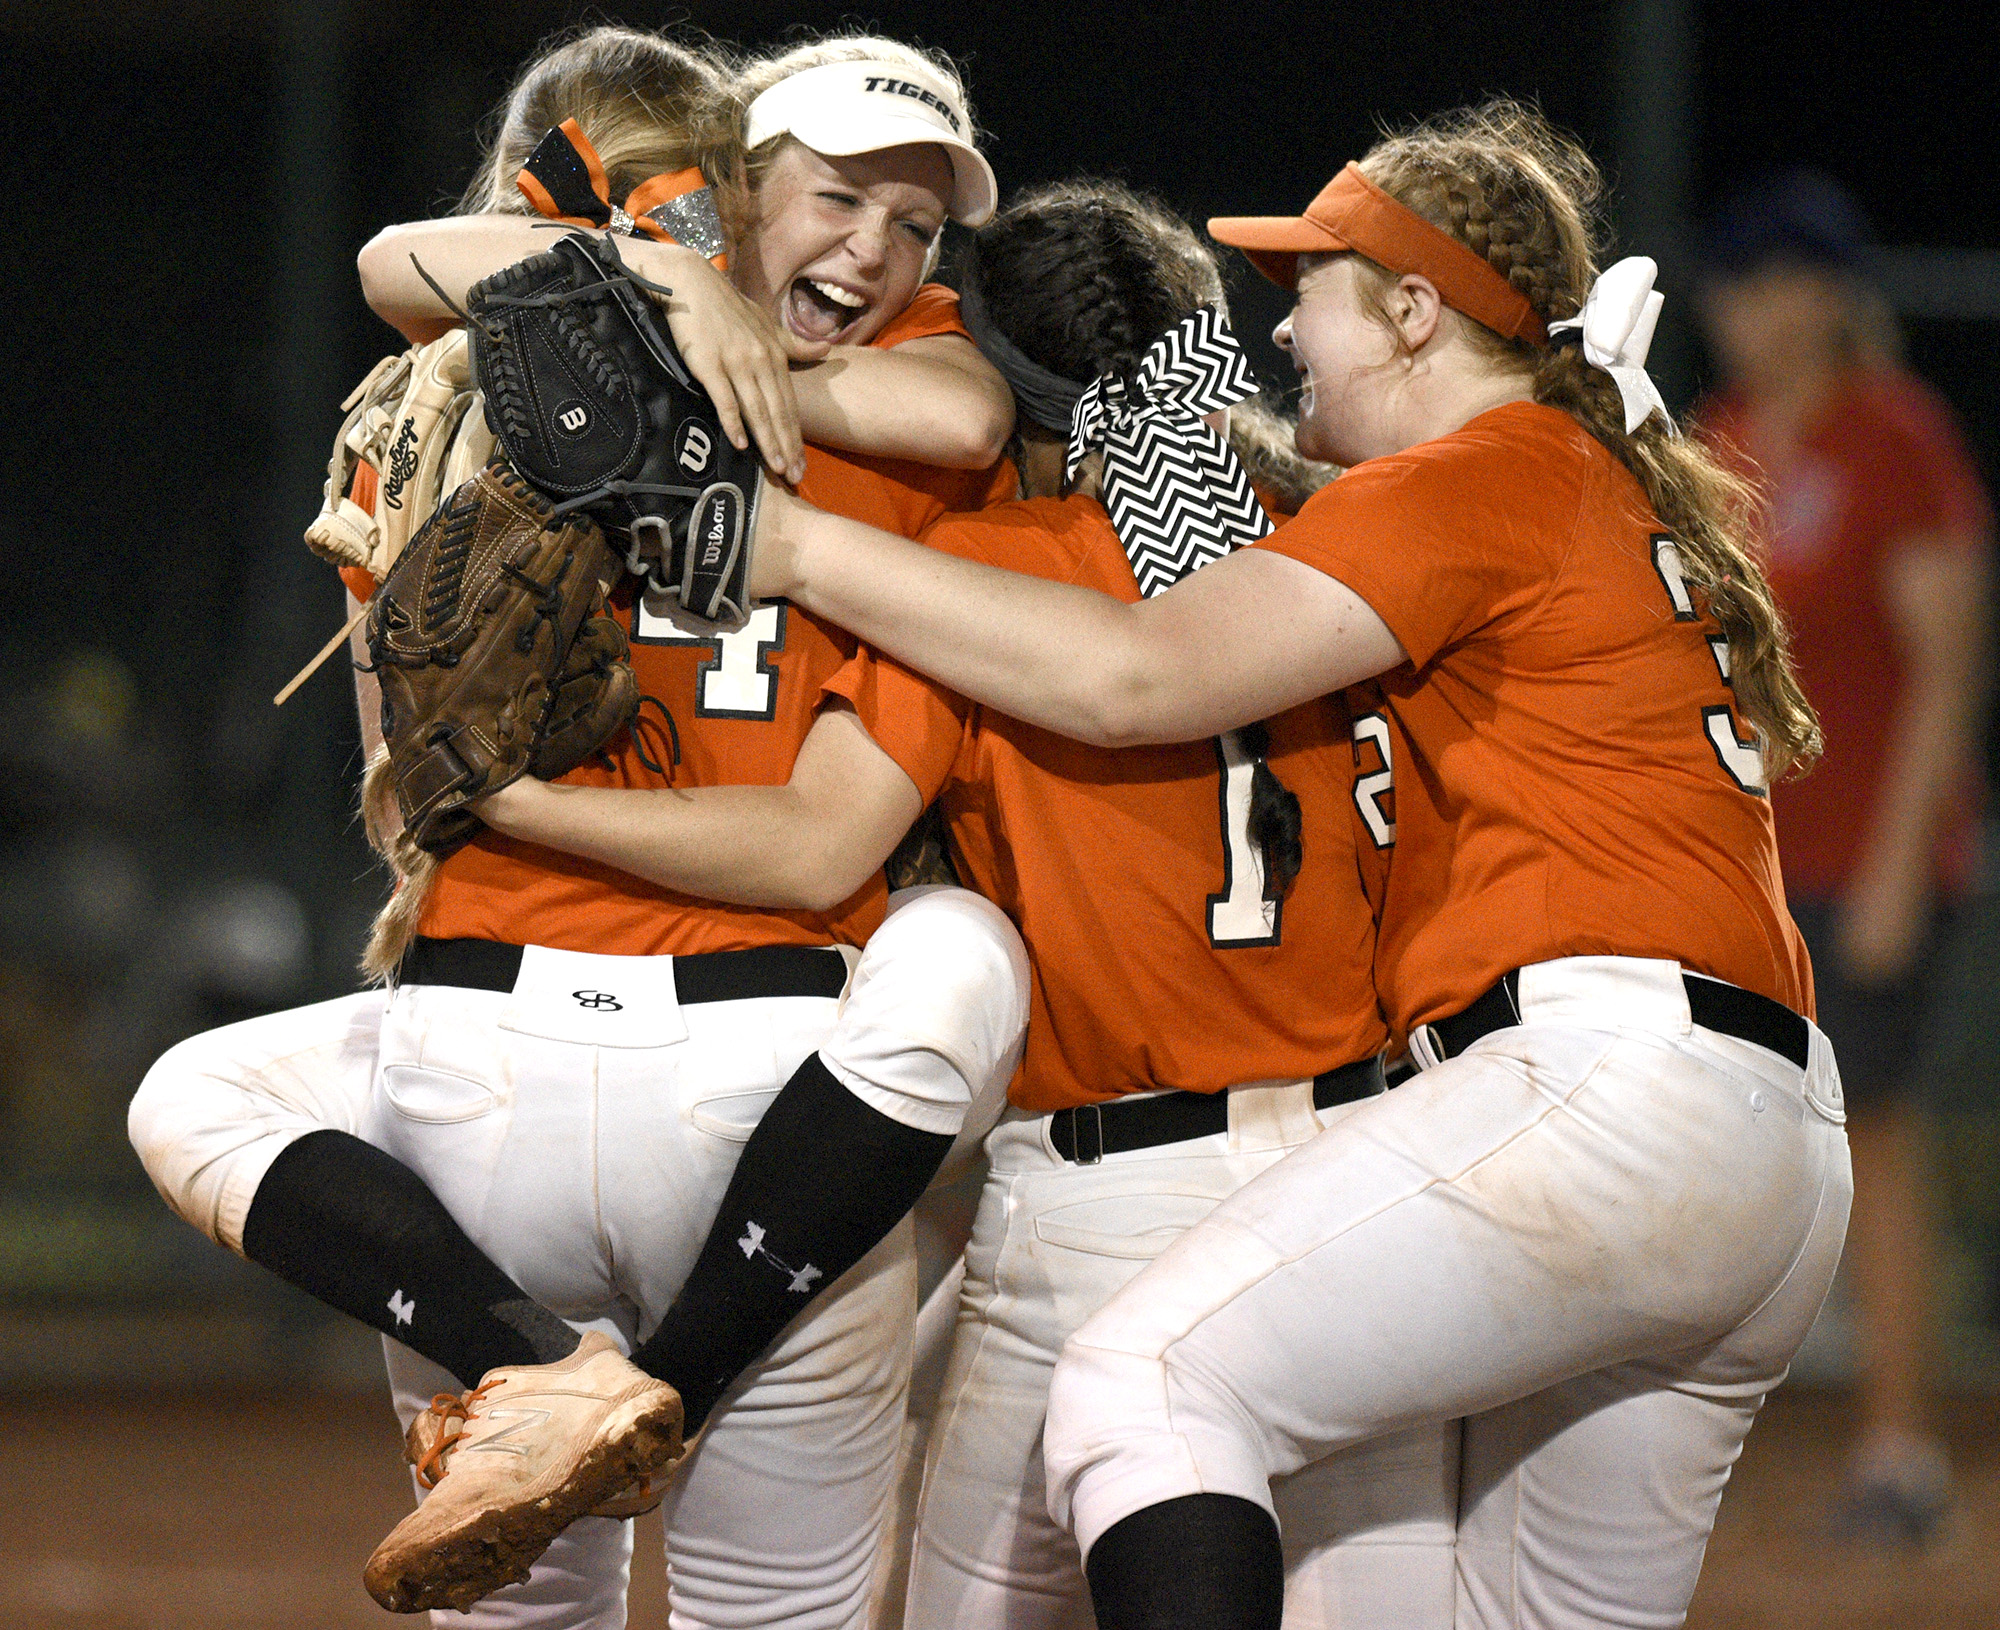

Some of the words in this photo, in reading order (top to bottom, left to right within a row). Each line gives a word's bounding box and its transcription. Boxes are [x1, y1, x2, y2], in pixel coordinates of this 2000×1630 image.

[865, 76, 960, 133] TIGERS
[384, 416, 418, 509] Rawlings
[702, 498, 726, 566] Wilson
